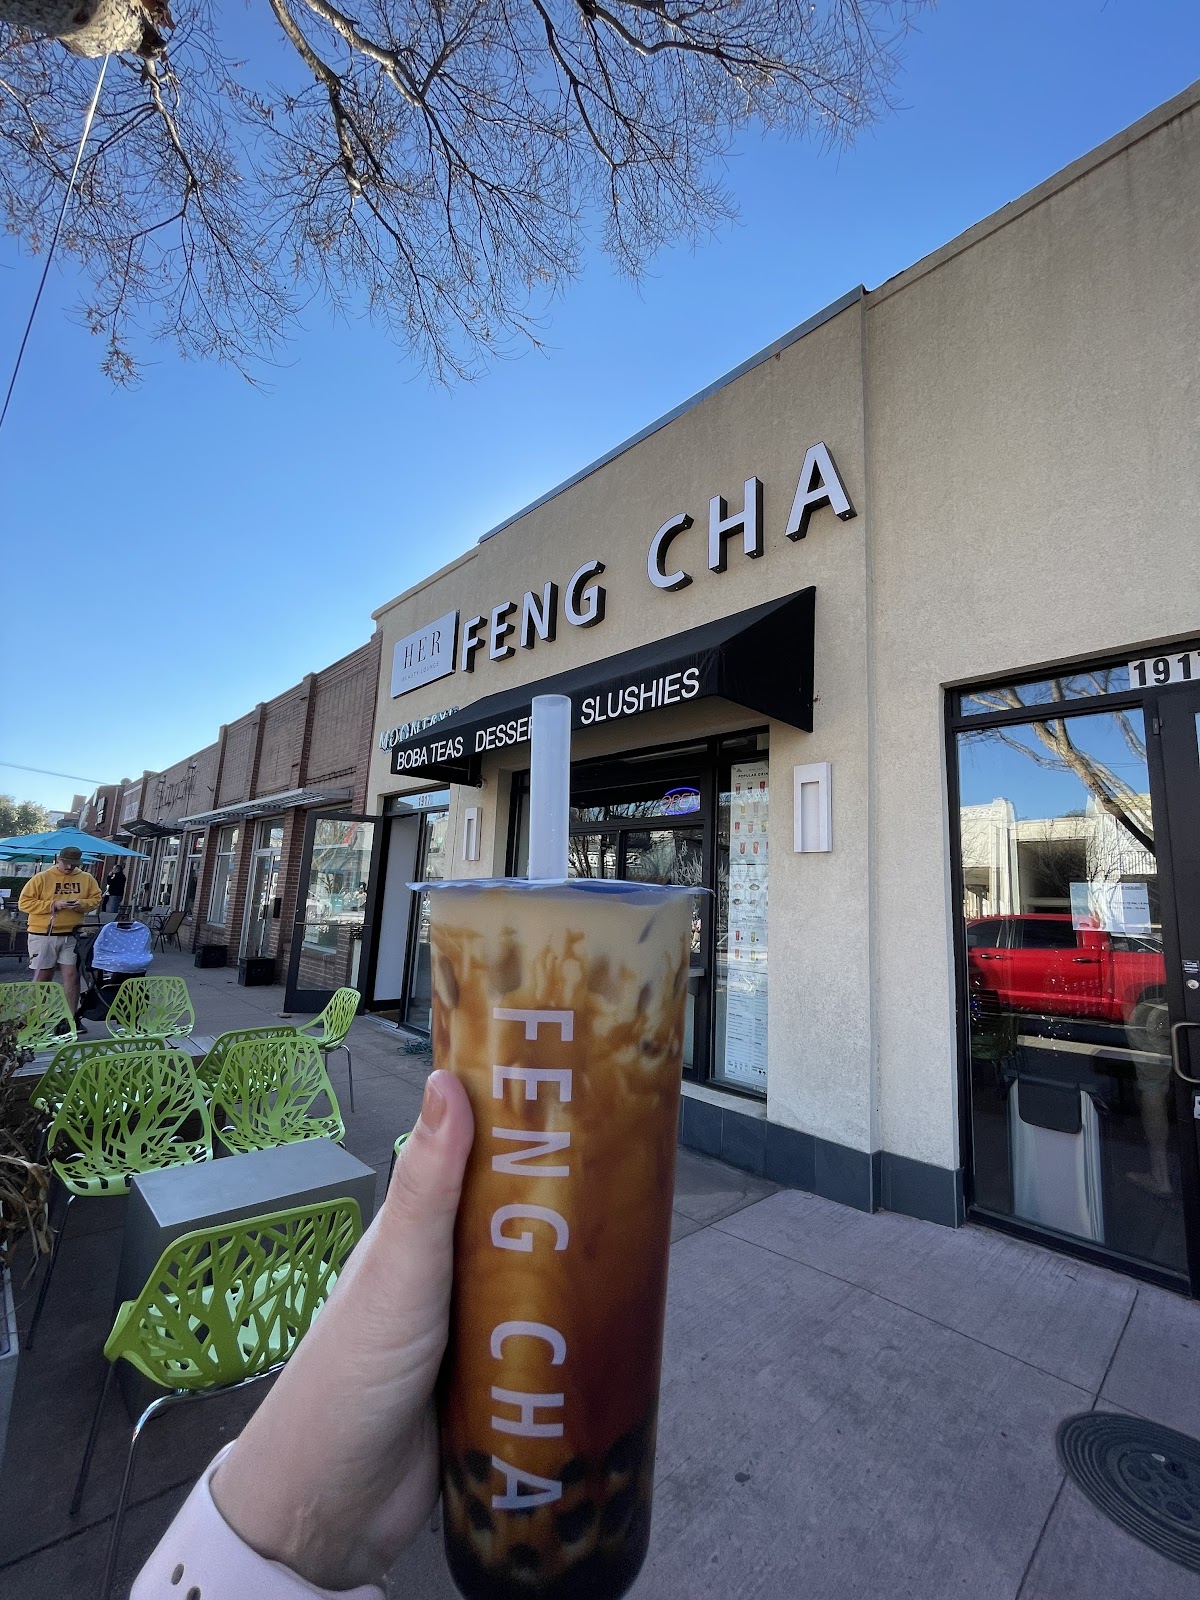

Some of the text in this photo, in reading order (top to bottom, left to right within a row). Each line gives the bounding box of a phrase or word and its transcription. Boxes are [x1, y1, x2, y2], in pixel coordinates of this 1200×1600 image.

[461, 441, 857, 673] FENG CHA
[403, 630, 441, 670] HER
[1133, 651, 1200, 687] 191
[397, 747, 429, 770] BOBA
[430, 736, 464, 764] TEAS
[580, 667, 700, 726] SLUSHIES
[54, 882, 81, 895] ASU
[489, 1007, 574, 1509] FENG CHA
